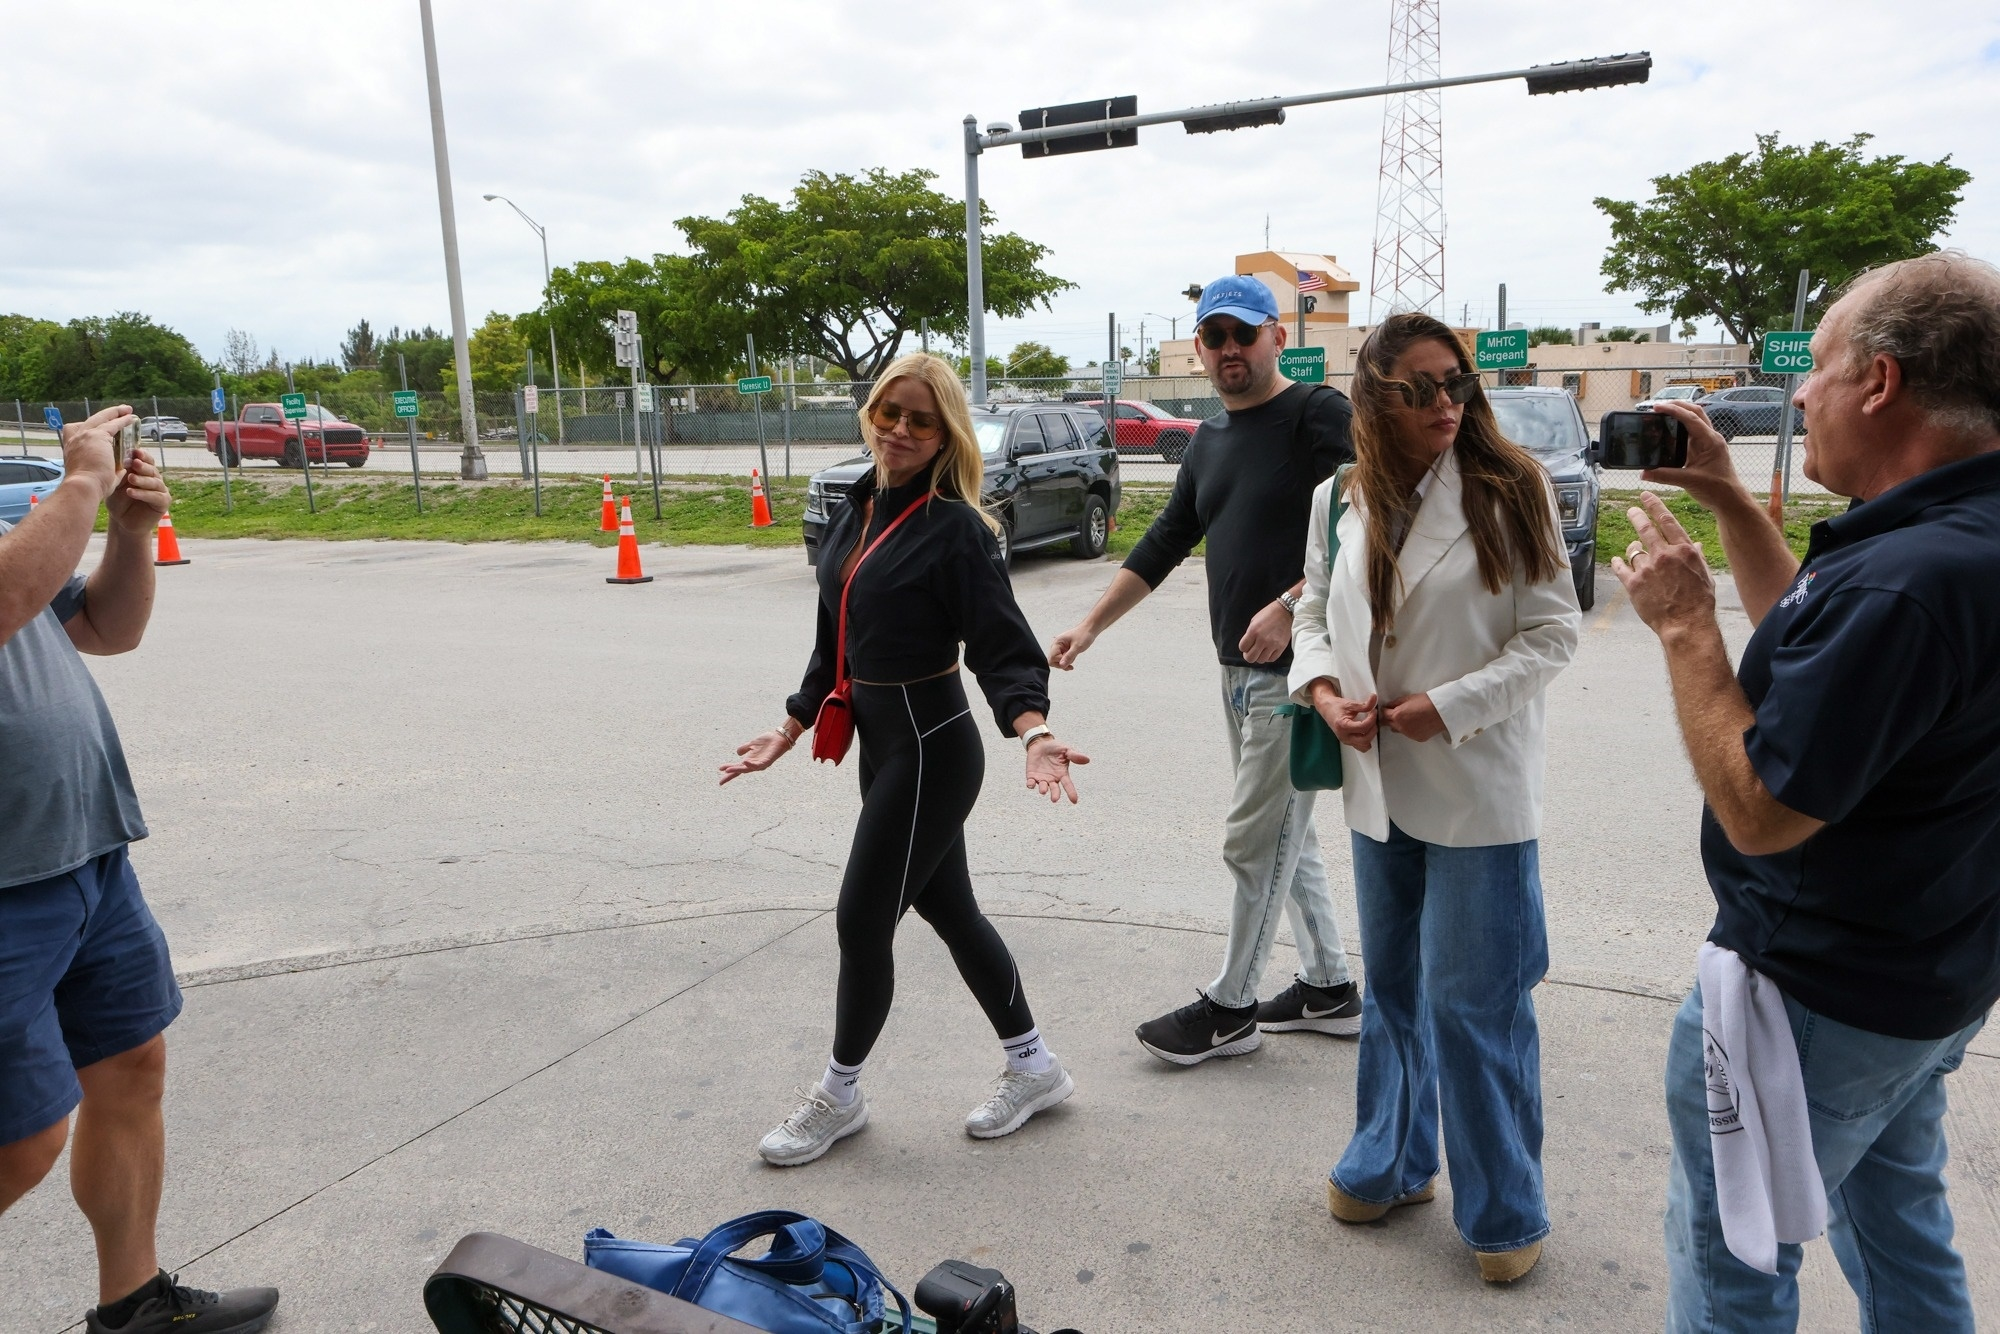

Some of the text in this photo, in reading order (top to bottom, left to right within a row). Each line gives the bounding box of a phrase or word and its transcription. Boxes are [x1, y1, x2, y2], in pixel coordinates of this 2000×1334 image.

[1211, 291, 1242, 300] NETJETS
[1487, 336, 1516, 348] MHTC
[1768, 340, 1811, 352] SHIF
[1280, 353, 1324, 365] Command
[1479, 349, 1524, 363] Sergeant
[1773, 355, 1812, 367] OIC
[1290, 366, 1313, 377] Staff
[741, 382, 762, 390] Forensic
[286, 398, 301, 406] Facility
[394, 396, 416, 404] EXECUTIVE
[284, 407, 306, 415] Supervisor
[397, 405, 416, 413] OFFICER
[991, 551, 1001, 560] alo
[1018, 1047, 1037, 1059] alo
